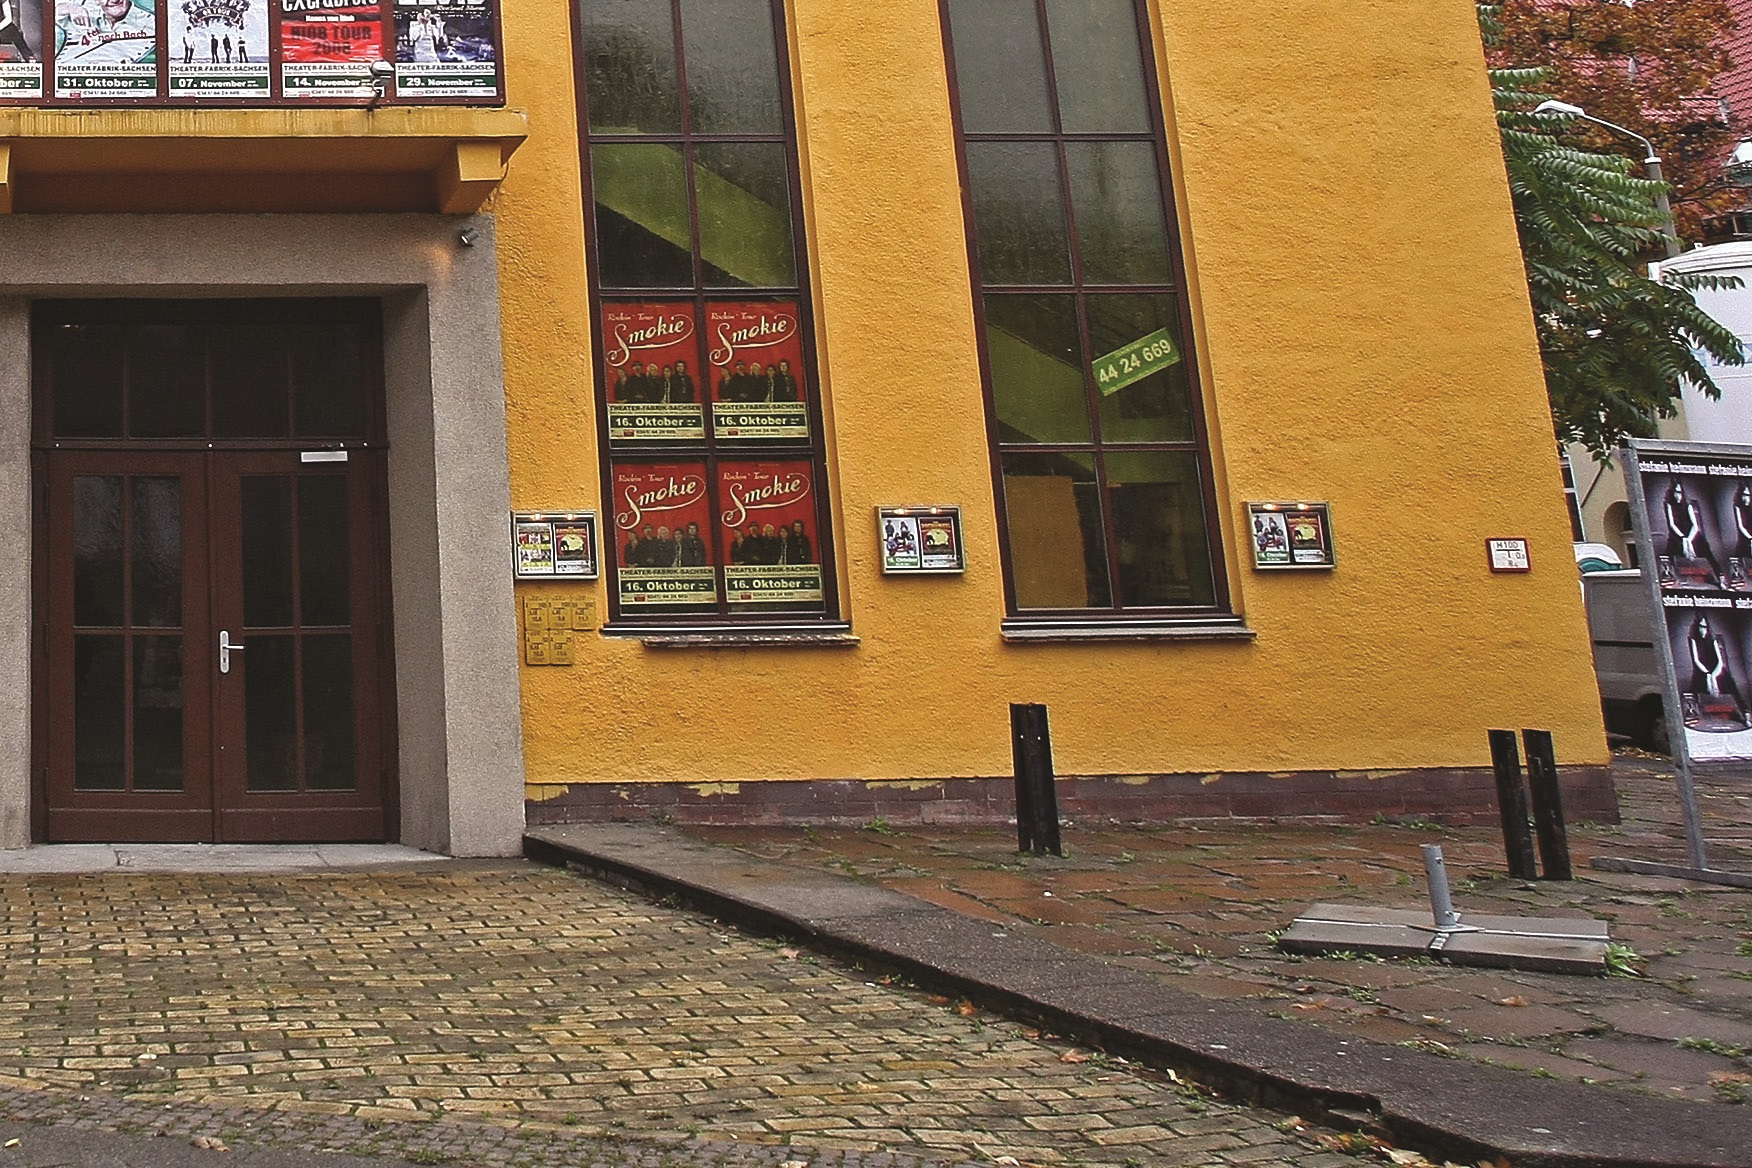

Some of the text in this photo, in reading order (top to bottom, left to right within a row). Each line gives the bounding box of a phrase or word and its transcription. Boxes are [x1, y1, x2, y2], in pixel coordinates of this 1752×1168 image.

[333, 25, 372, 40] TOUR
[63, 78, 82, 87] 31.
[84, 78, 134, 87] Oktober
[178, 78, 198, 88] 07.
[200, 80, 247, 88] November
[293, 77, 312, 87] 14.
[314, 78, 361, 87] November
[406, 77, 426, 86] 29.
[427, 78, 474, 86] November
[606, 314, 694, 367] Smokie
[709, 313, 797, 366] Smokie
[1100, 363, 1119, 383] 44
[1120, 353, 1141, 374] 24
[1142, 339, 1171, 362] 669
[615, 417, 684, 426] 16. Oktober
[719, 416, 787, 425] 16. Oktober
[1639, 461, 1669, 473] stefanie
[1669, 462, 1707, 475] heinzmann
[1708, 463, 1738, 476] stefanie
[616, 474, 706, 530] Smokie
[721, 472, 810, 528] Smokie
[625, 581, 696, 591] 16. Oktober
[732, 579, 801, 589] 16. Oktober
[1663, 595, 1694, 607] stefanie
